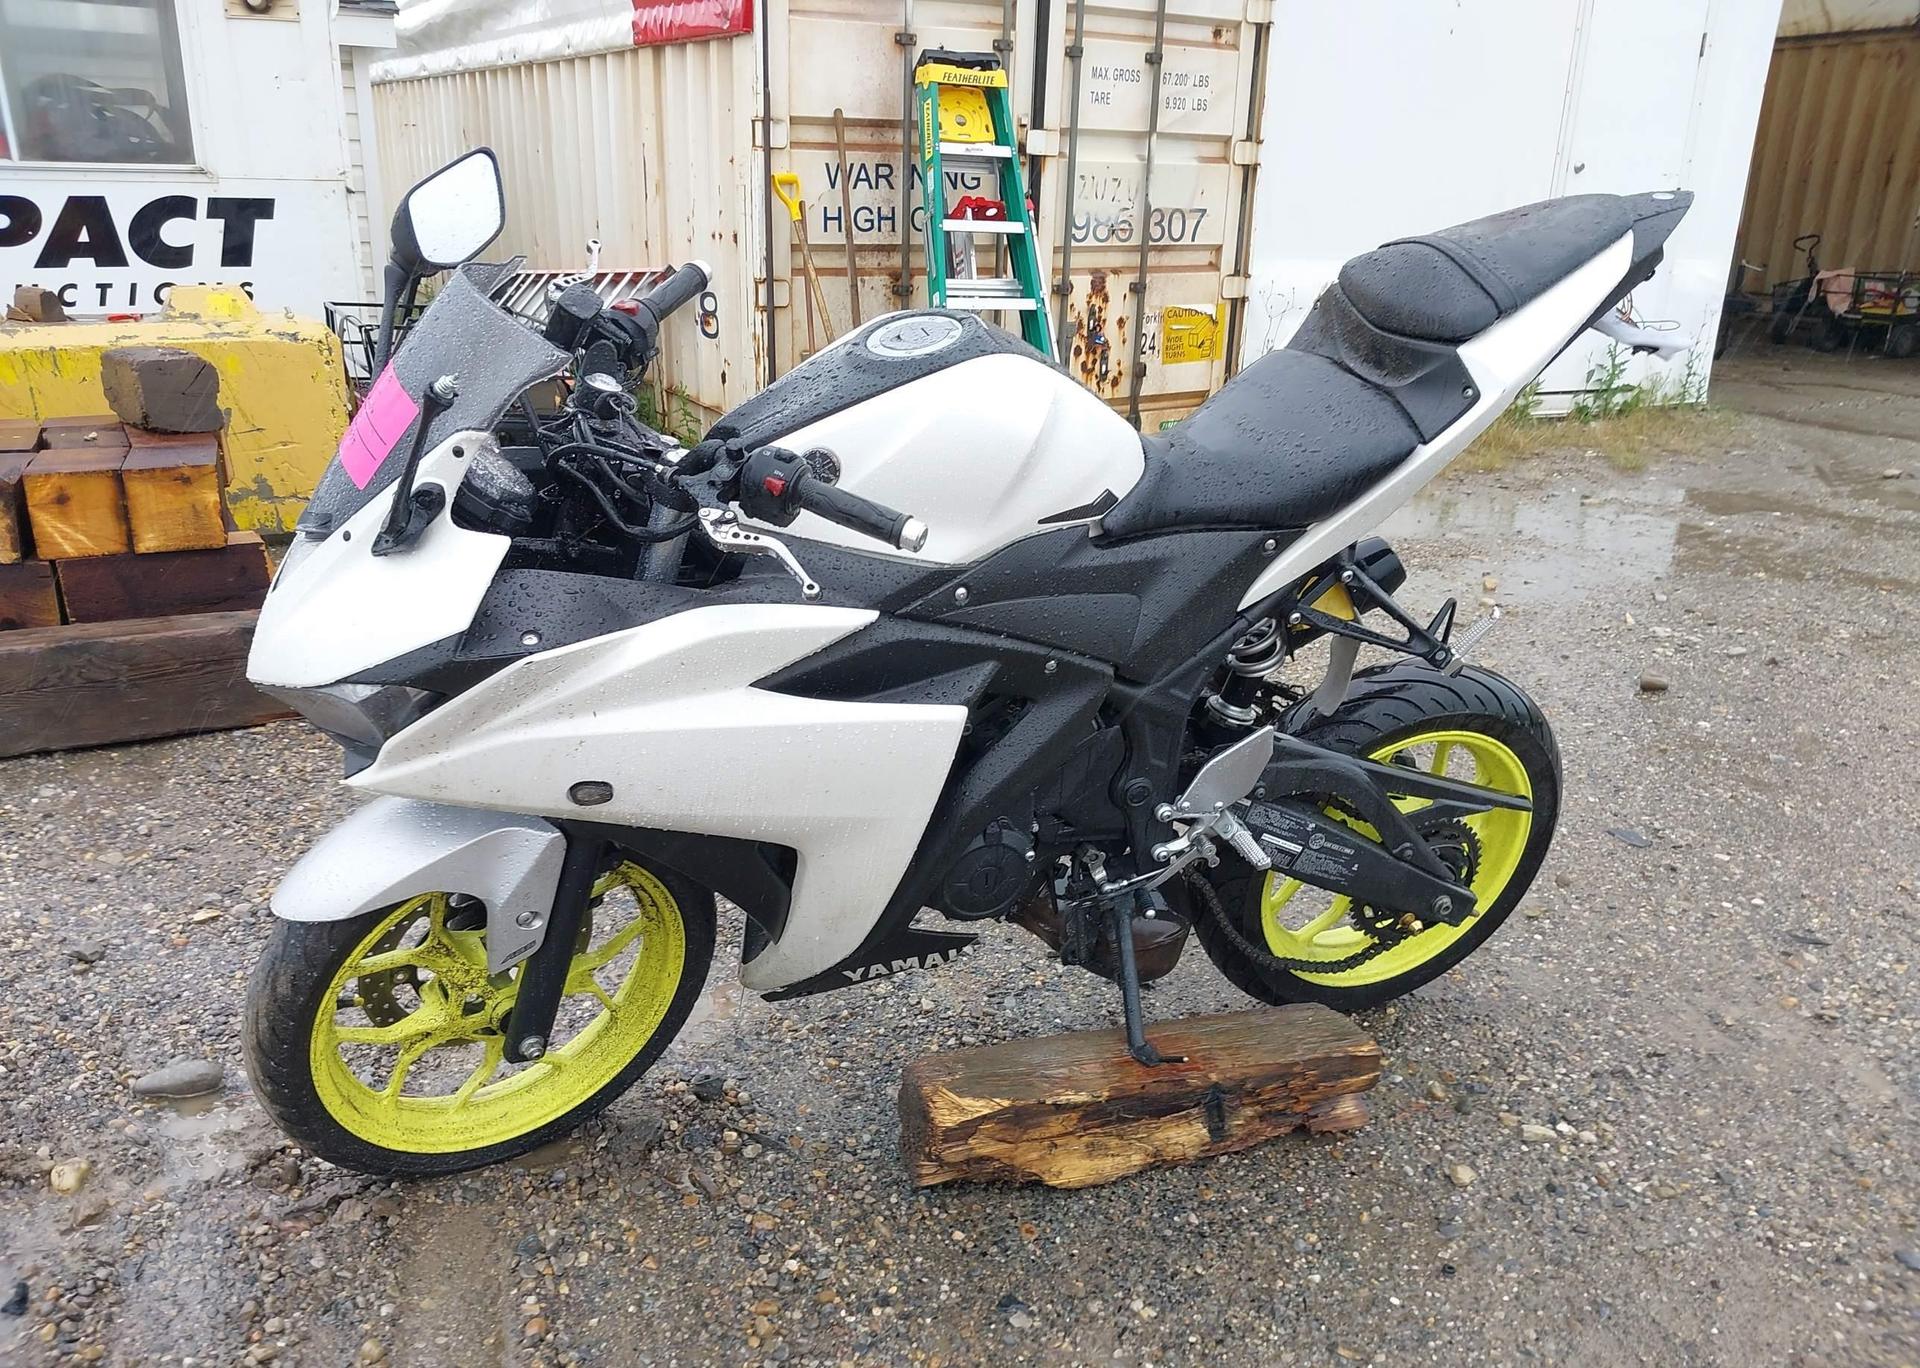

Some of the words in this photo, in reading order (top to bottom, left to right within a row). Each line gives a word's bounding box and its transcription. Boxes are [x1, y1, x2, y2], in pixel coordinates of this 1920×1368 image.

[942, 71, 996, 85] FEATHERLITE
[1091, 66, 1111, 81] MAX.
[1113, 68, 1141, 83] GROSS
[1193, 74, 1210, 88] LBS
[1090, 91, 1111, 105] TARE
[1165, 96, 1187, 111] 9.920
[1191, 98, 1208, 112] LBS
[825, 162, 981, 190] WARNNG
[823, 206, 896, 233] HGH
[1165, 343, 1184, 351] RIGHT
[1166, 335, 1183, 343] WIDE
[1165, 351, 1186, 359] TURNS
